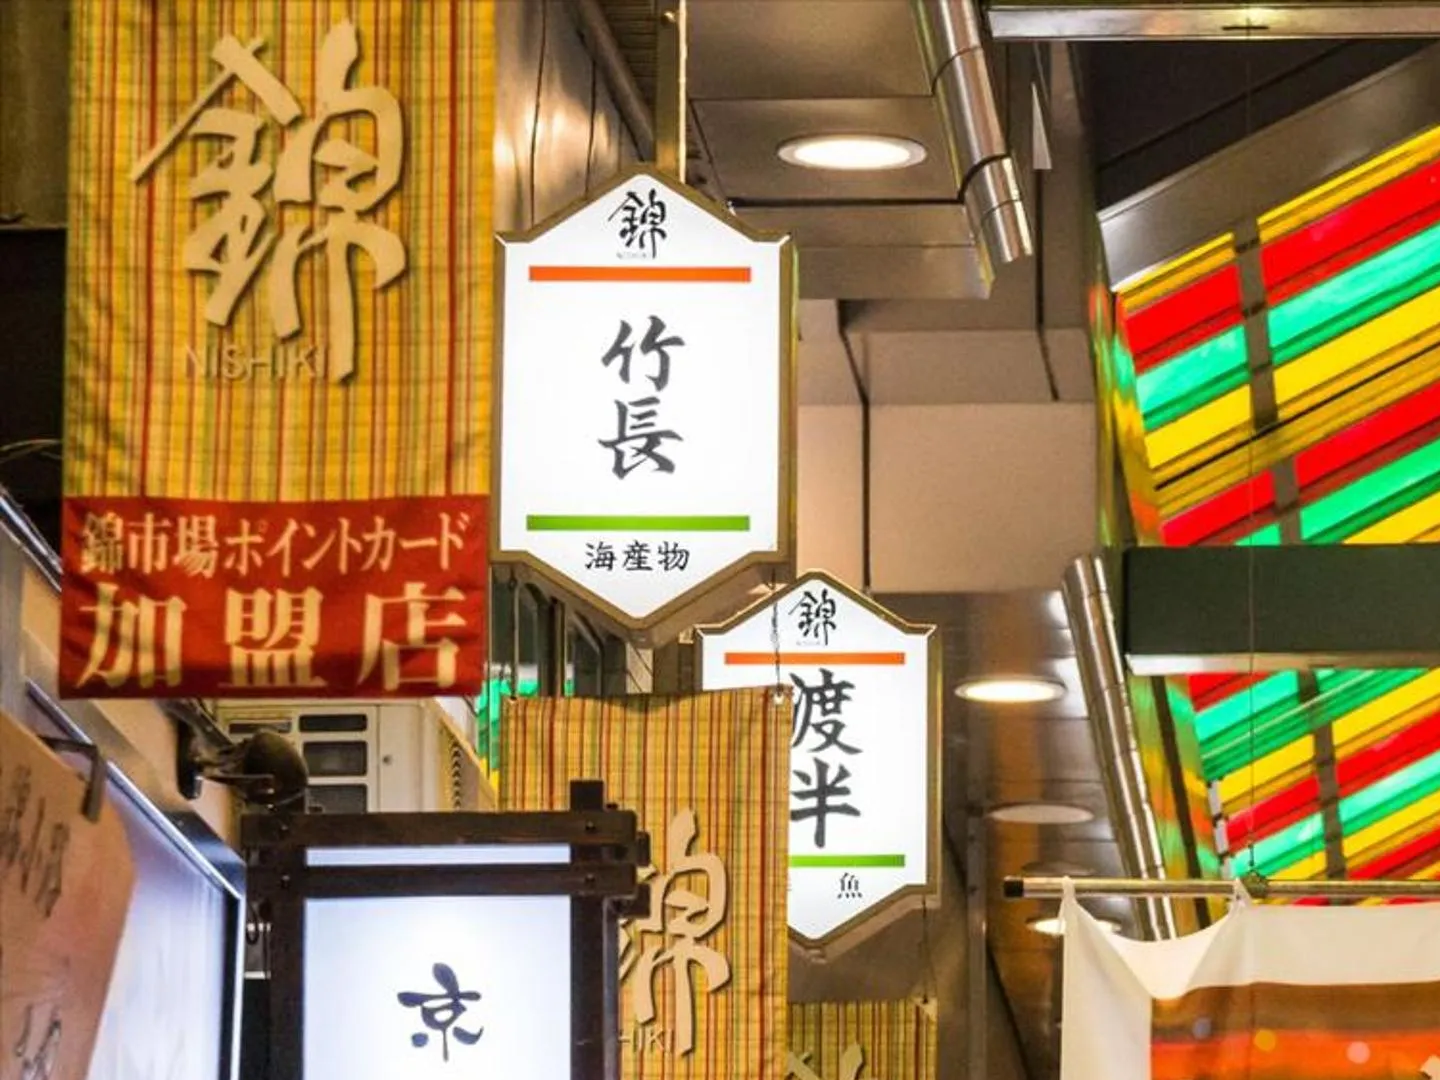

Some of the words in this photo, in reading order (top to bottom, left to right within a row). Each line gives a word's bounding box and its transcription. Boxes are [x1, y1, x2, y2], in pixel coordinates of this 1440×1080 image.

[131, 17, 407, 383] 錦
[608, 188, 667, 259] 錦
[184, 345, 328, 381] NISHIKI
[598, 314, 686, 480] 竹長
[79, 511, 470, 579] 錦市場ポイントカード
[584, 540, 690, 573] 海産物
[75, 581, 467, 691] 加盟店
[789, 588, 837, 646] 錦
